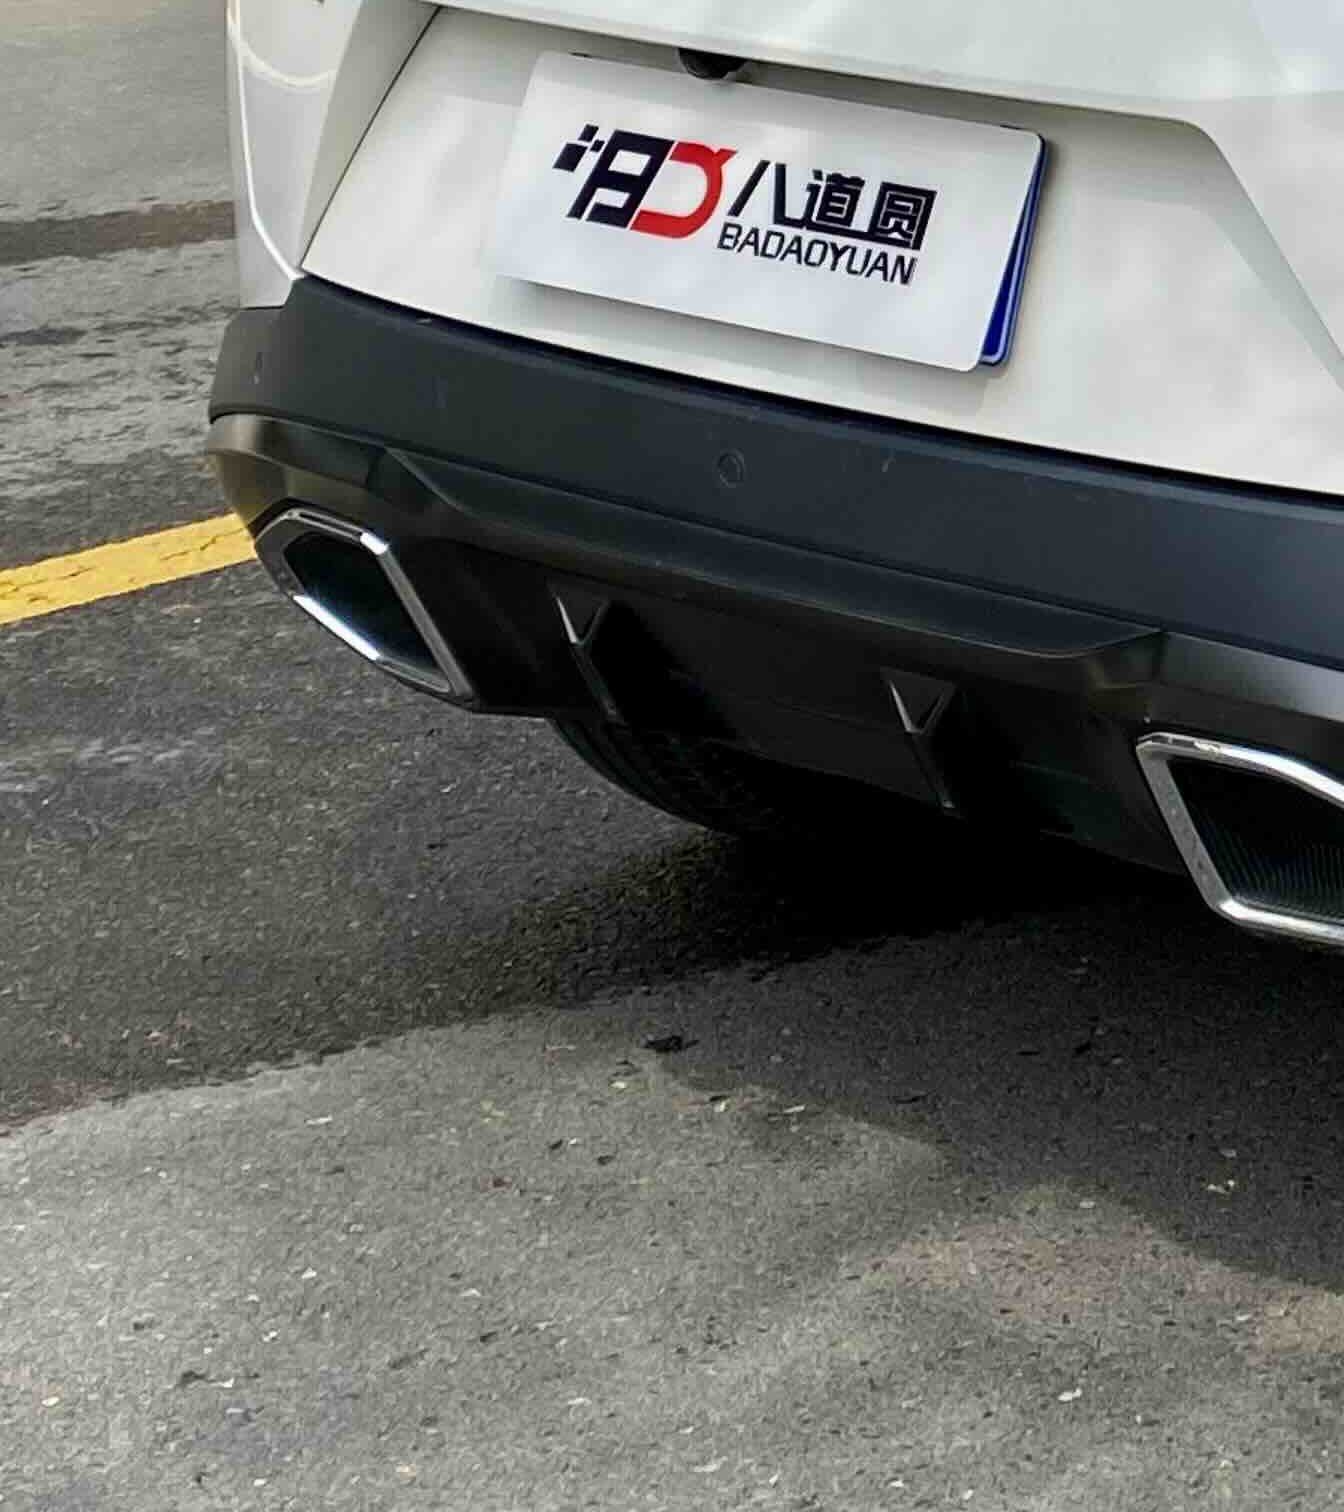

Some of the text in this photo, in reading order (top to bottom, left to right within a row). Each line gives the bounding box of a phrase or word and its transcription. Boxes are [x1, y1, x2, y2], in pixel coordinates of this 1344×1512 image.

[727, 159, 938, 251] 八道圆
[717, 221, 918, 285] BADAOYUAN
